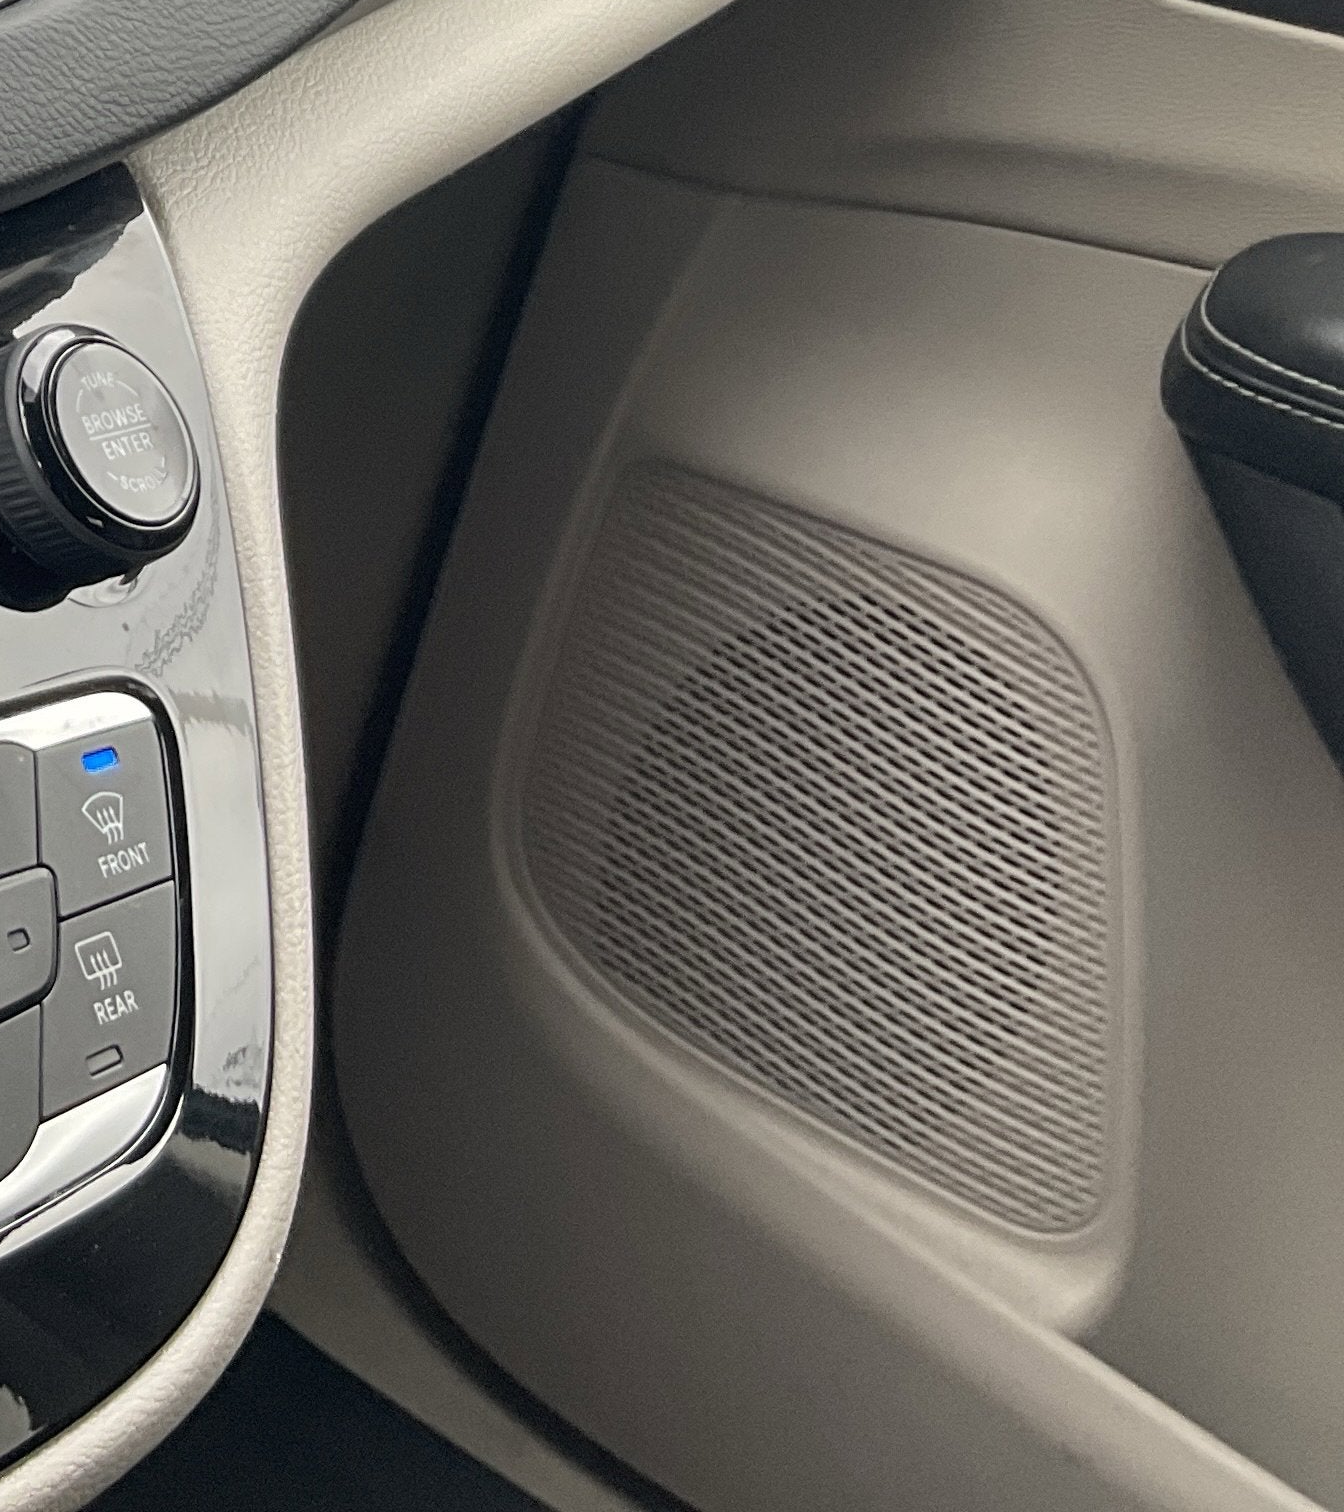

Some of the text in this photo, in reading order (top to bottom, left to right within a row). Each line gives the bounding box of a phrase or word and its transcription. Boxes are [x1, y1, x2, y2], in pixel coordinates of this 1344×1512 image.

[81, 372, 114, 390] TUNE
[81, 404, 146, 434] BROWSE
[101, 431, 154, 461] ENTER
[119, 469, 167, 493] SCROLL
[98, 841, 150, 878] FRONT
[93, 990, 139, 1025] REAR
